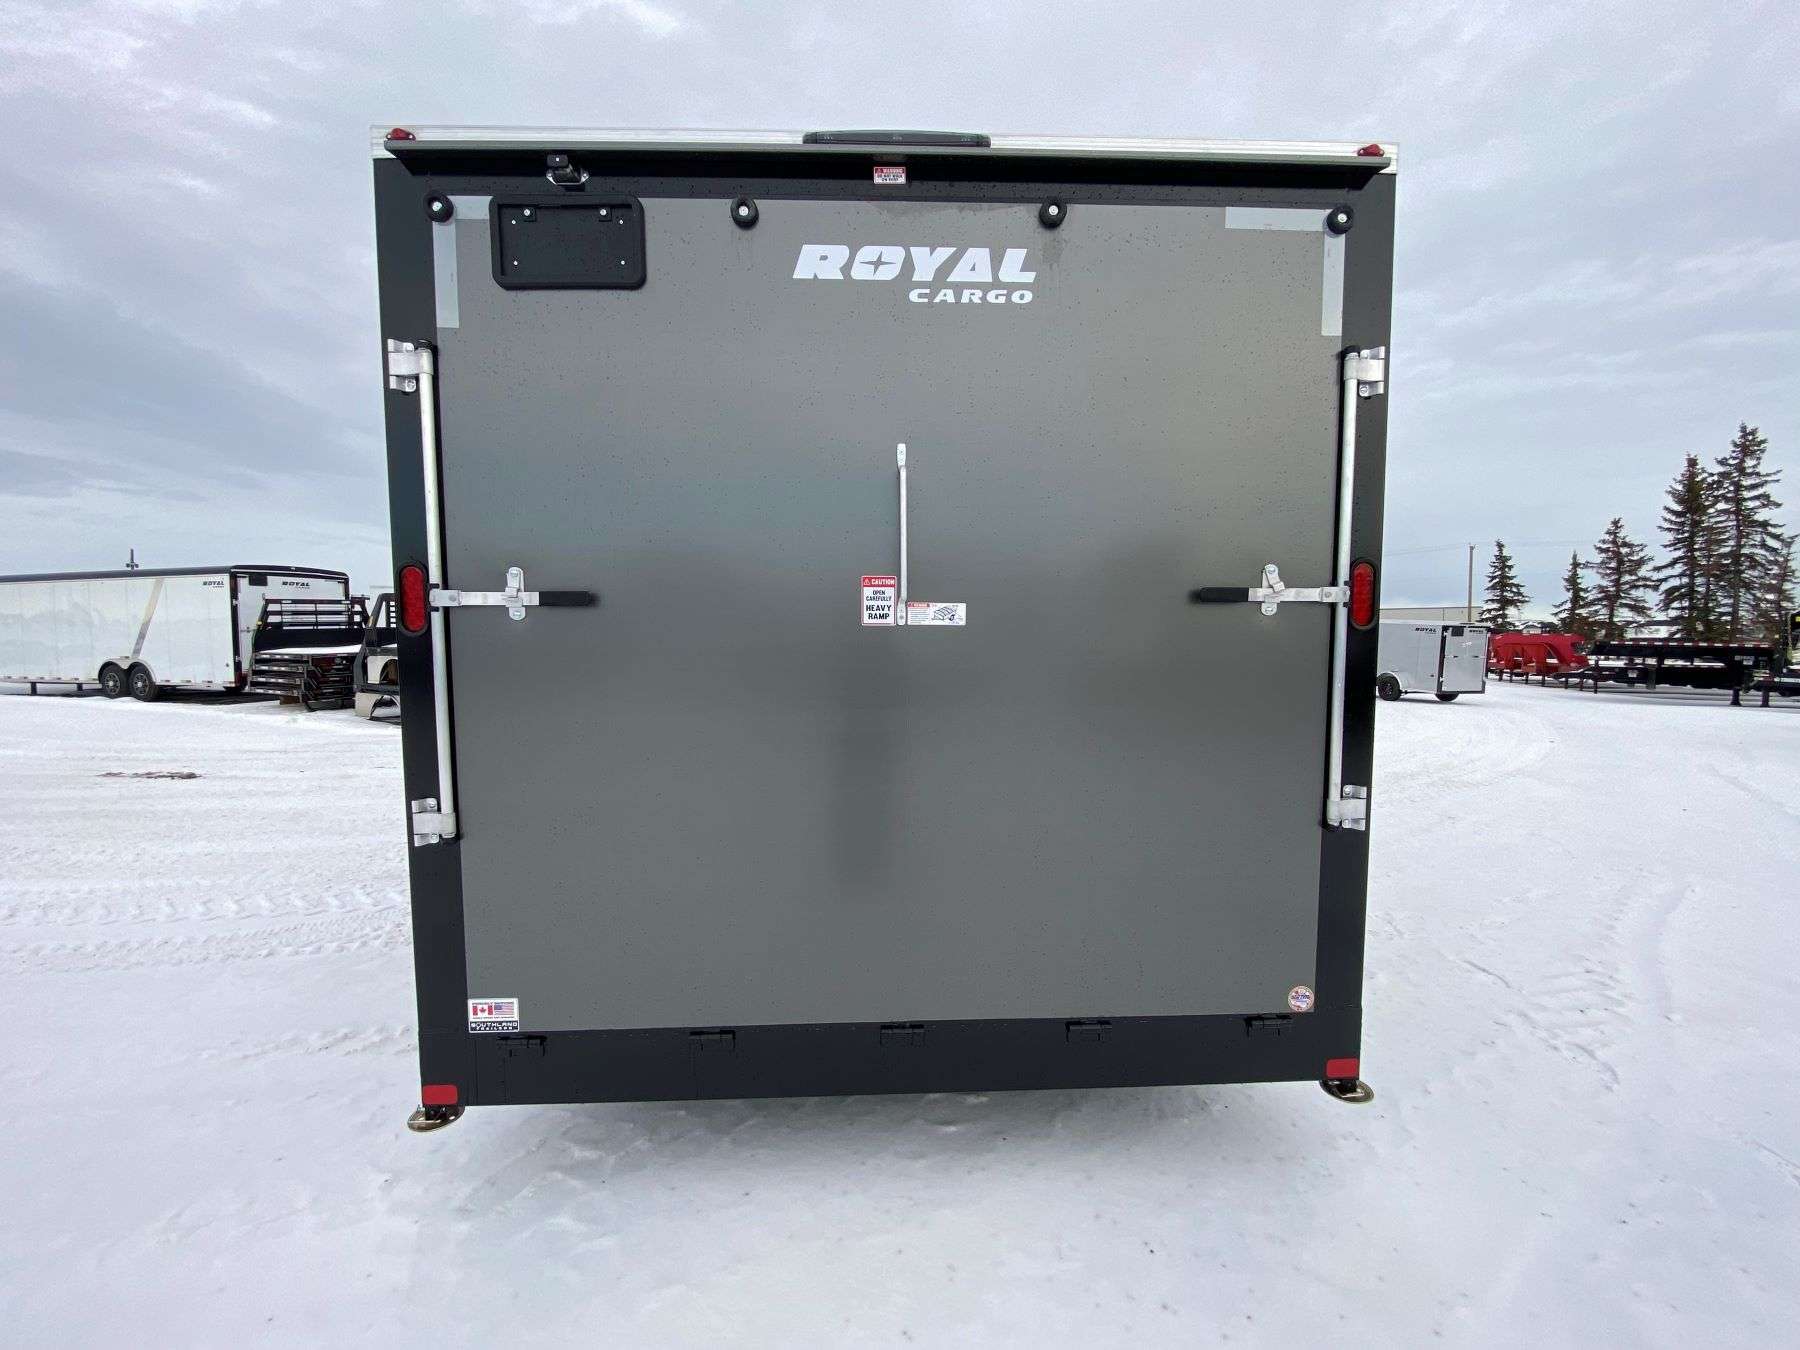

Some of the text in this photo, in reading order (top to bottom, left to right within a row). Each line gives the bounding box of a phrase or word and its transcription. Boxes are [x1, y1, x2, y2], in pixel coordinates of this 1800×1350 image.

[793, 244, 1037, 283] ROYAL
[908, 288, 1033, 304] CARGO
[866, 604, 892, 612] HEAVY
